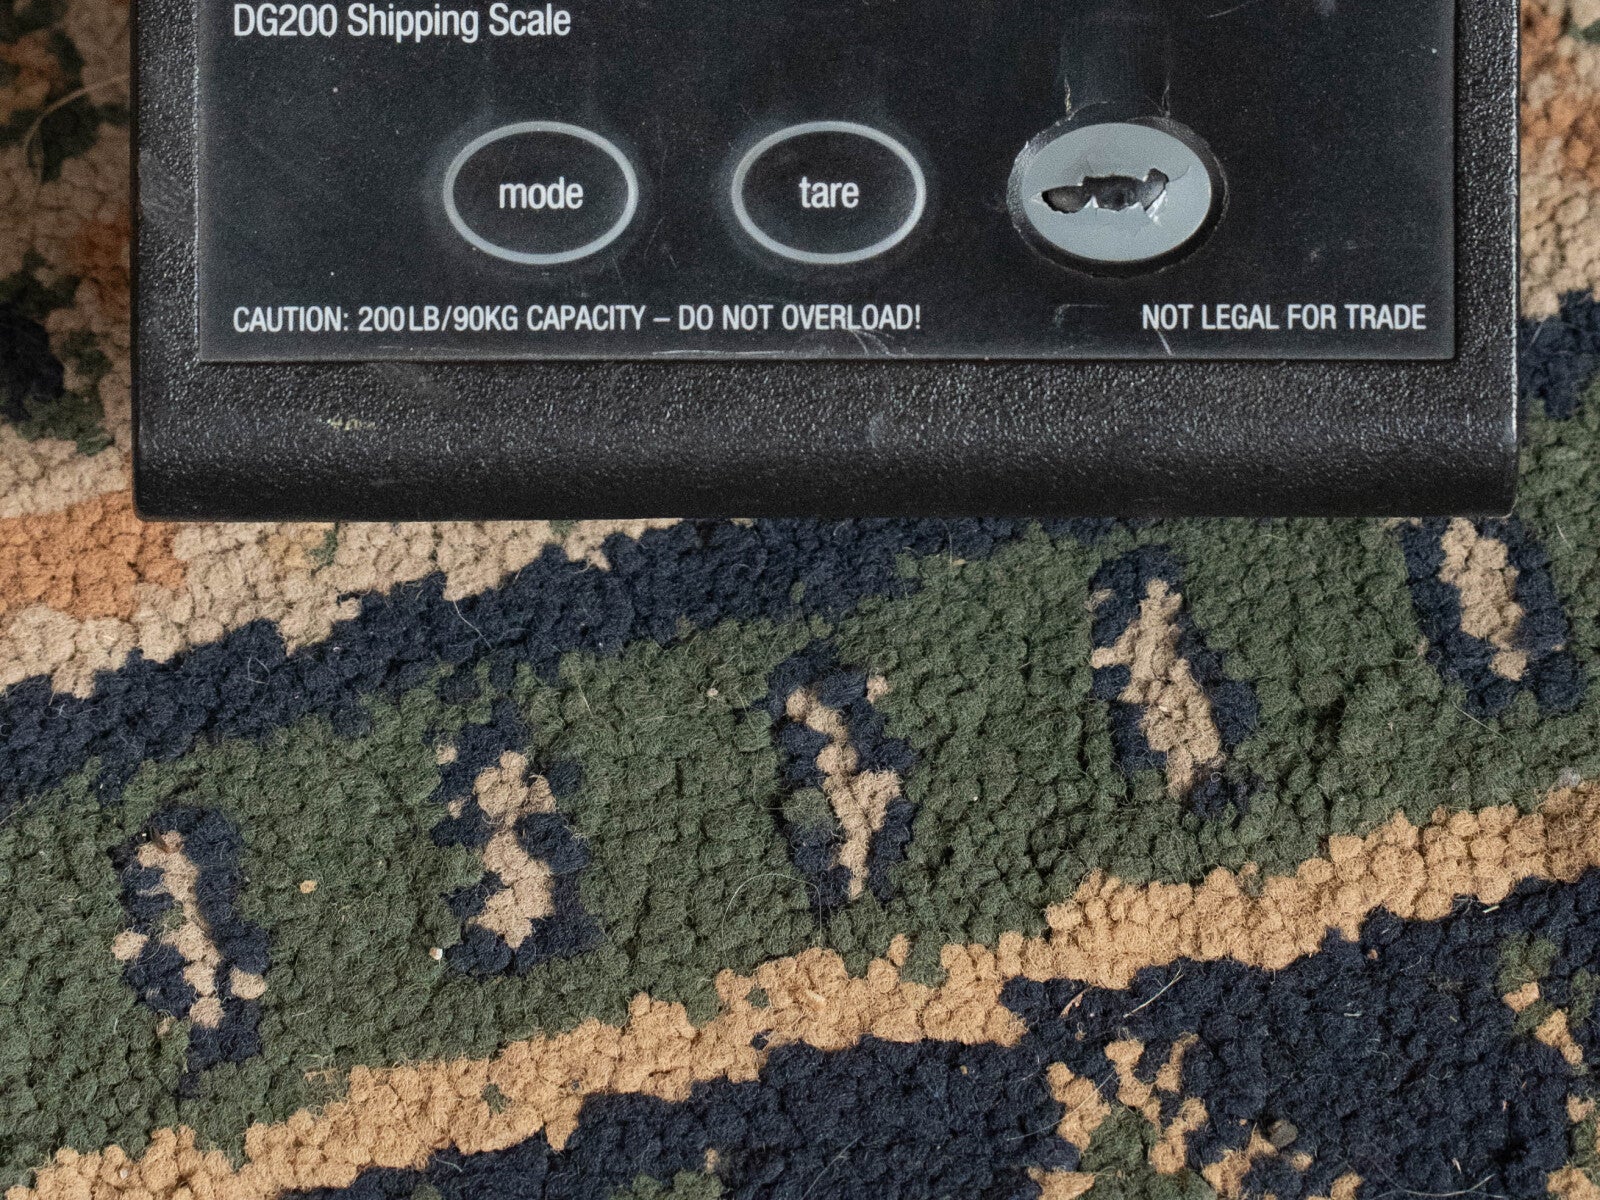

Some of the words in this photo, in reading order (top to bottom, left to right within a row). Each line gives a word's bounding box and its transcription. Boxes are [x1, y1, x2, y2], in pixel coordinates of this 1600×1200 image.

[233, 3, 338, 37] DG200
[347, 3, 479, 44] Shipping
[488, 3, 571, 36] Scale
[498, 178, 584, 210] mode
[798, 178, 860, 209] tare
[233, 306, 349, 332] CAUTION:
[526, 304, 646, 331] CAPACITY
[678, 304, 714, 330] DO
[722, 304, 774, 330] NOT
[781, 304, 921, 330] OVERLOAD!
[1142, 304, 1194, 330] NOT
[1202, 304, 1279, 330] LEGAL
[1287, 304, 1337, 330] FOR
[1345, 304, 1427, 330] TRADE
